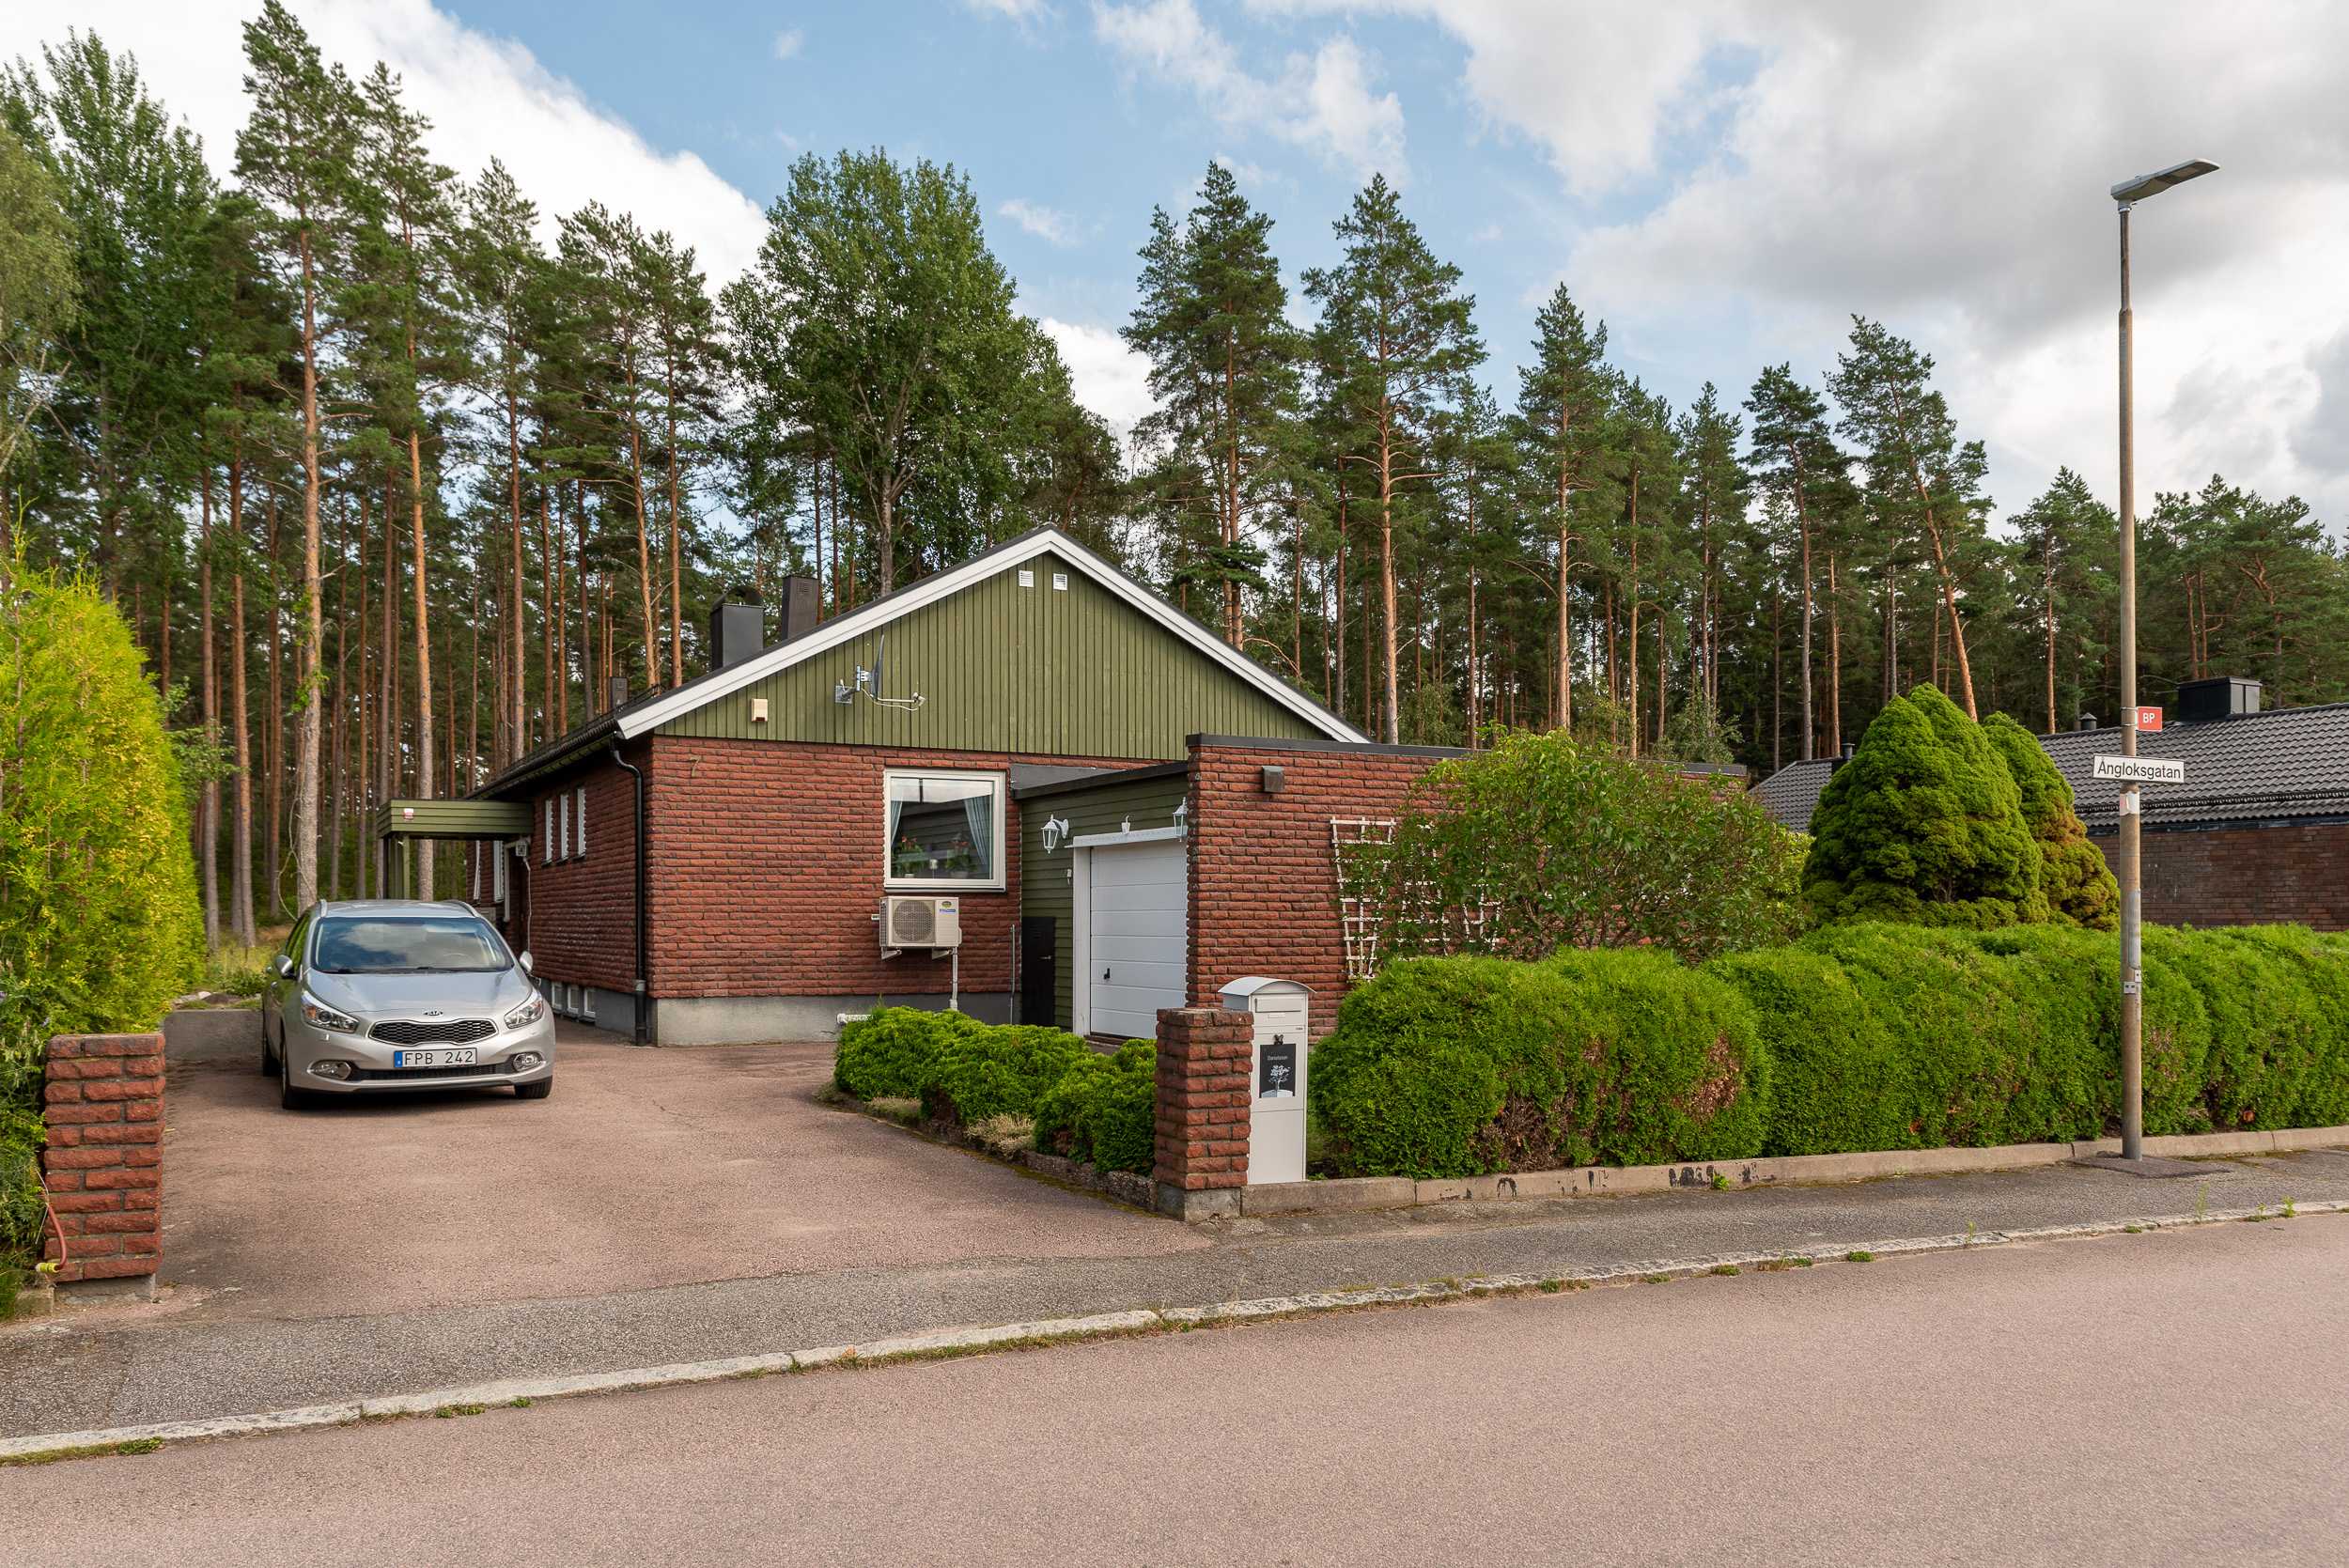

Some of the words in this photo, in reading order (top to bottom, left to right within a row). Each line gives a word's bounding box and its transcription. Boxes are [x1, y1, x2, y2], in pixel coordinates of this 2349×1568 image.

[2142, 712, 2155, 723] BP
[690, 756, 701, 777] 7
[2097, 757, 2181, 780] Ångloksgatan
[405, 1052, 433, 1065] FPB
[445, 1050, 474, 1063] 242
